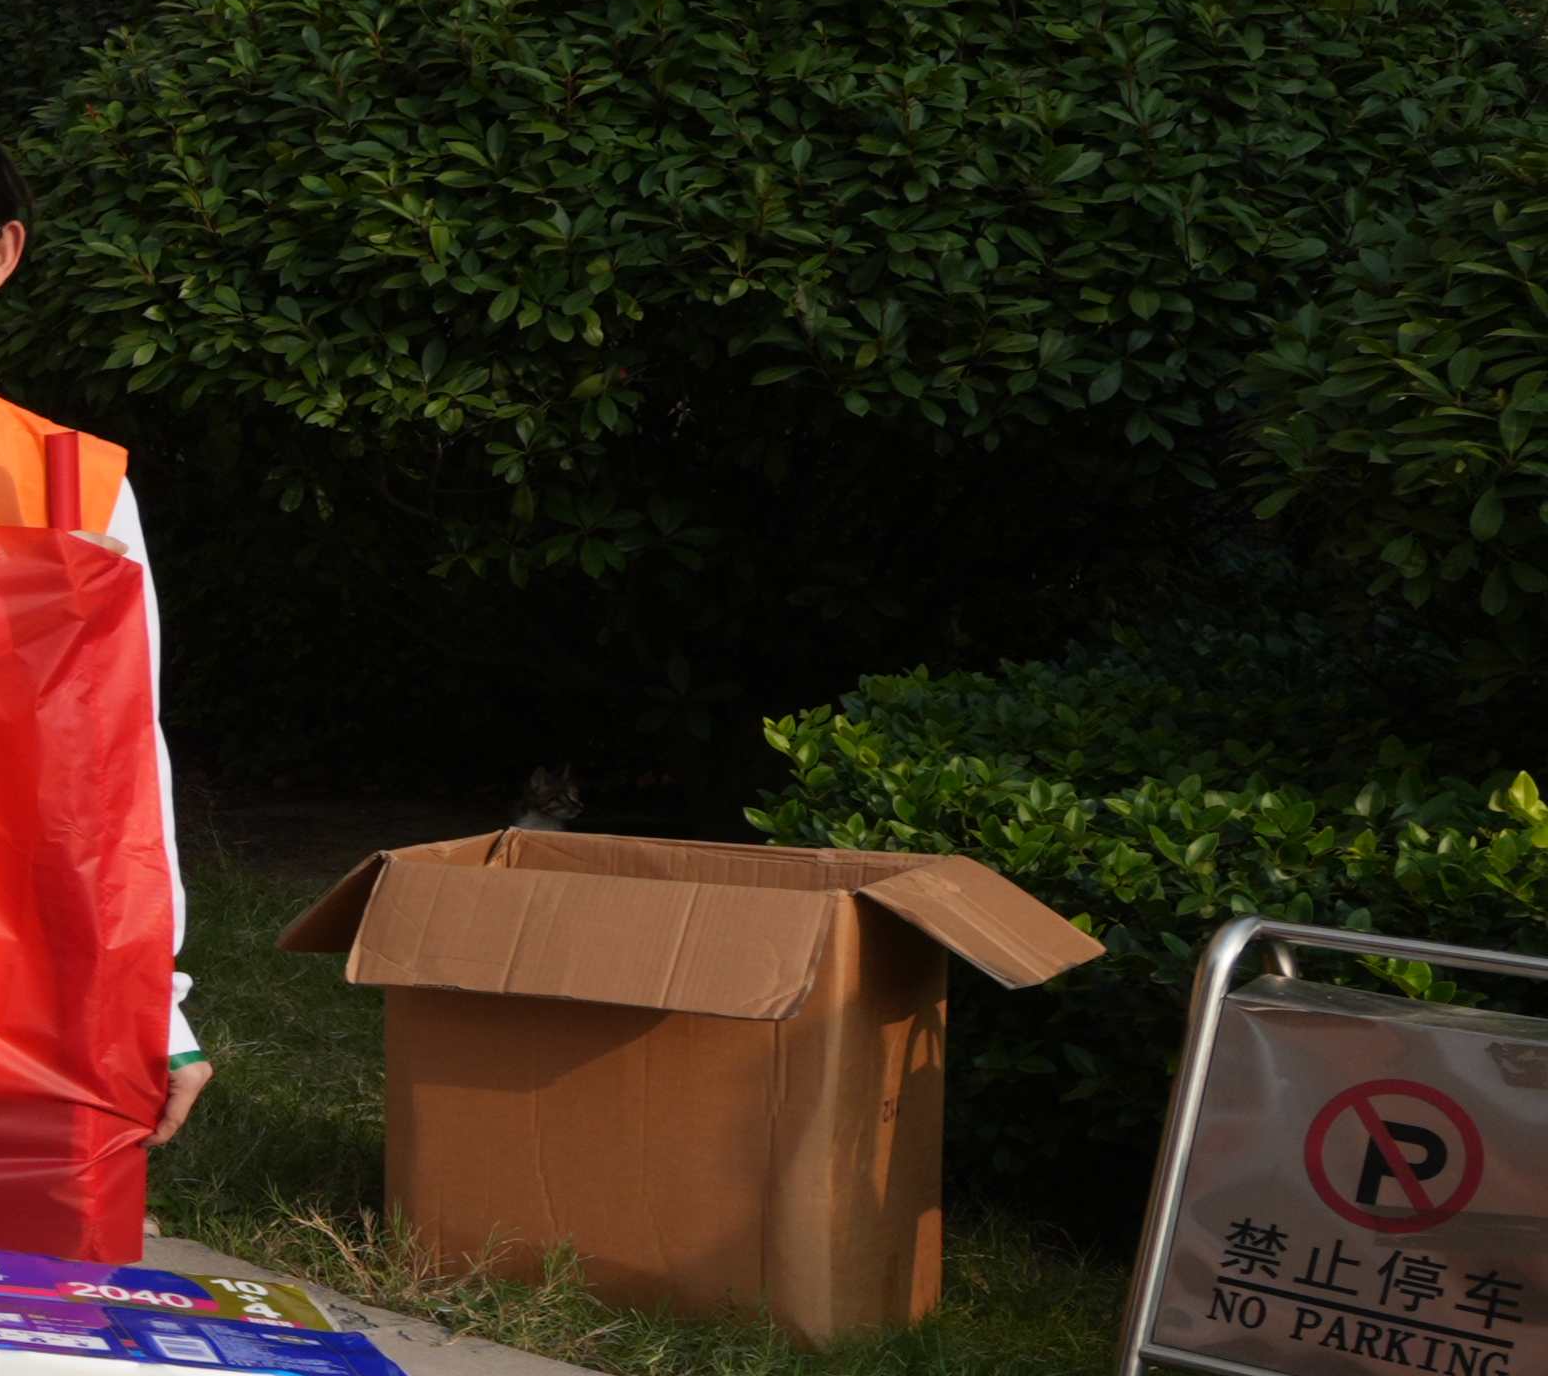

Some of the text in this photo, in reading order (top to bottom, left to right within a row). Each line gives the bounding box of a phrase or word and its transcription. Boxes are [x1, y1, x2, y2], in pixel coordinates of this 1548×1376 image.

[210, 1278, 268, 1297] 10
[1217, 1217, 1524, 1330] 禁止停车
[68, 1280, 194, 1309] 2040
[1206, 1287, 1266, 1329] NO
[243, 1301, 283, 1321] 4
